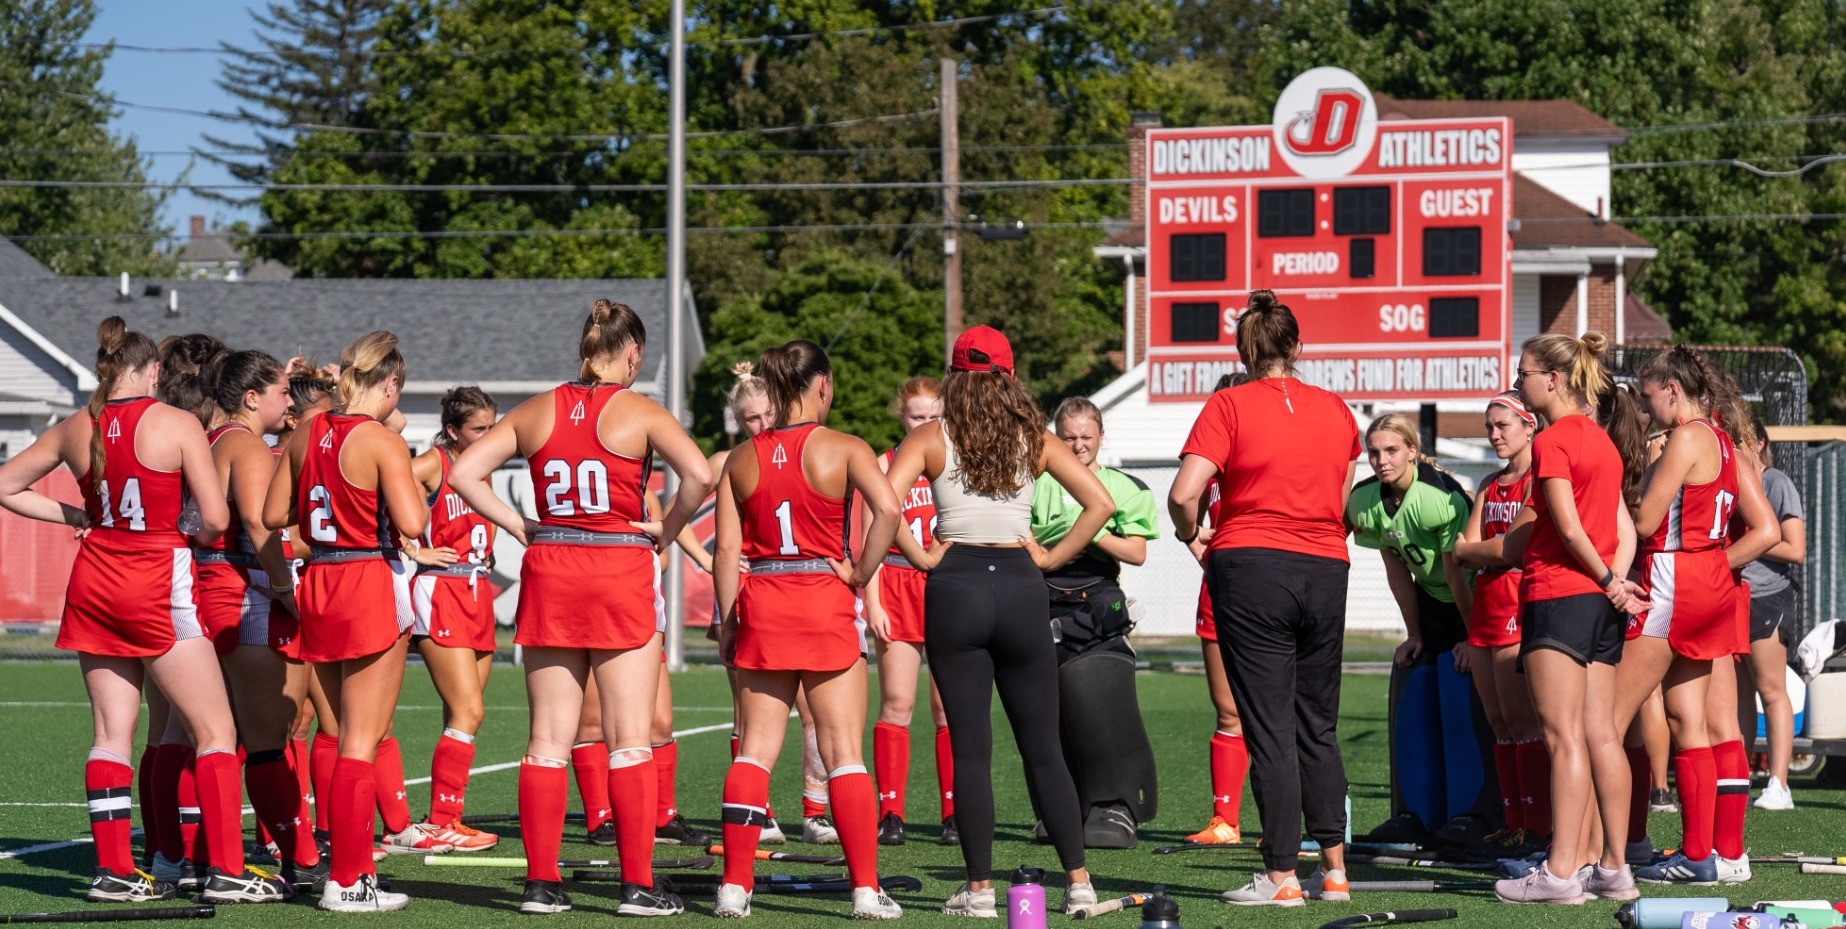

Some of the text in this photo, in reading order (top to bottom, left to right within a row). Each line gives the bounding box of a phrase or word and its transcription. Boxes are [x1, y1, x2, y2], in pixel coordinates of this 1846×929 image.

[1153, 129, 1501, 174] DICKINSON ATHLETICS
[1159, 196, 1238, 224] DEVILS
[1420, 188, 1493, 217] GUEST
[1273, 252, 1339, 275] PERIOD
[1380, 304, 1425, 332] SOG
[1151, 361, 1163, 395] A
[1164, 361, 1194, 395] GIFT
[1357, 358, 1394, 392] FUND
[1396, 358, 1424, 391] FOR
[1425, 356, 1499, 390] ATHLETICS
[100, 477, 147, 532] 14
[543, 459, 610, 516] 20
[309, 484, 338, 543] 2
[774, 500, 800, 556] 1
[467, 524, 489, 564] 9
